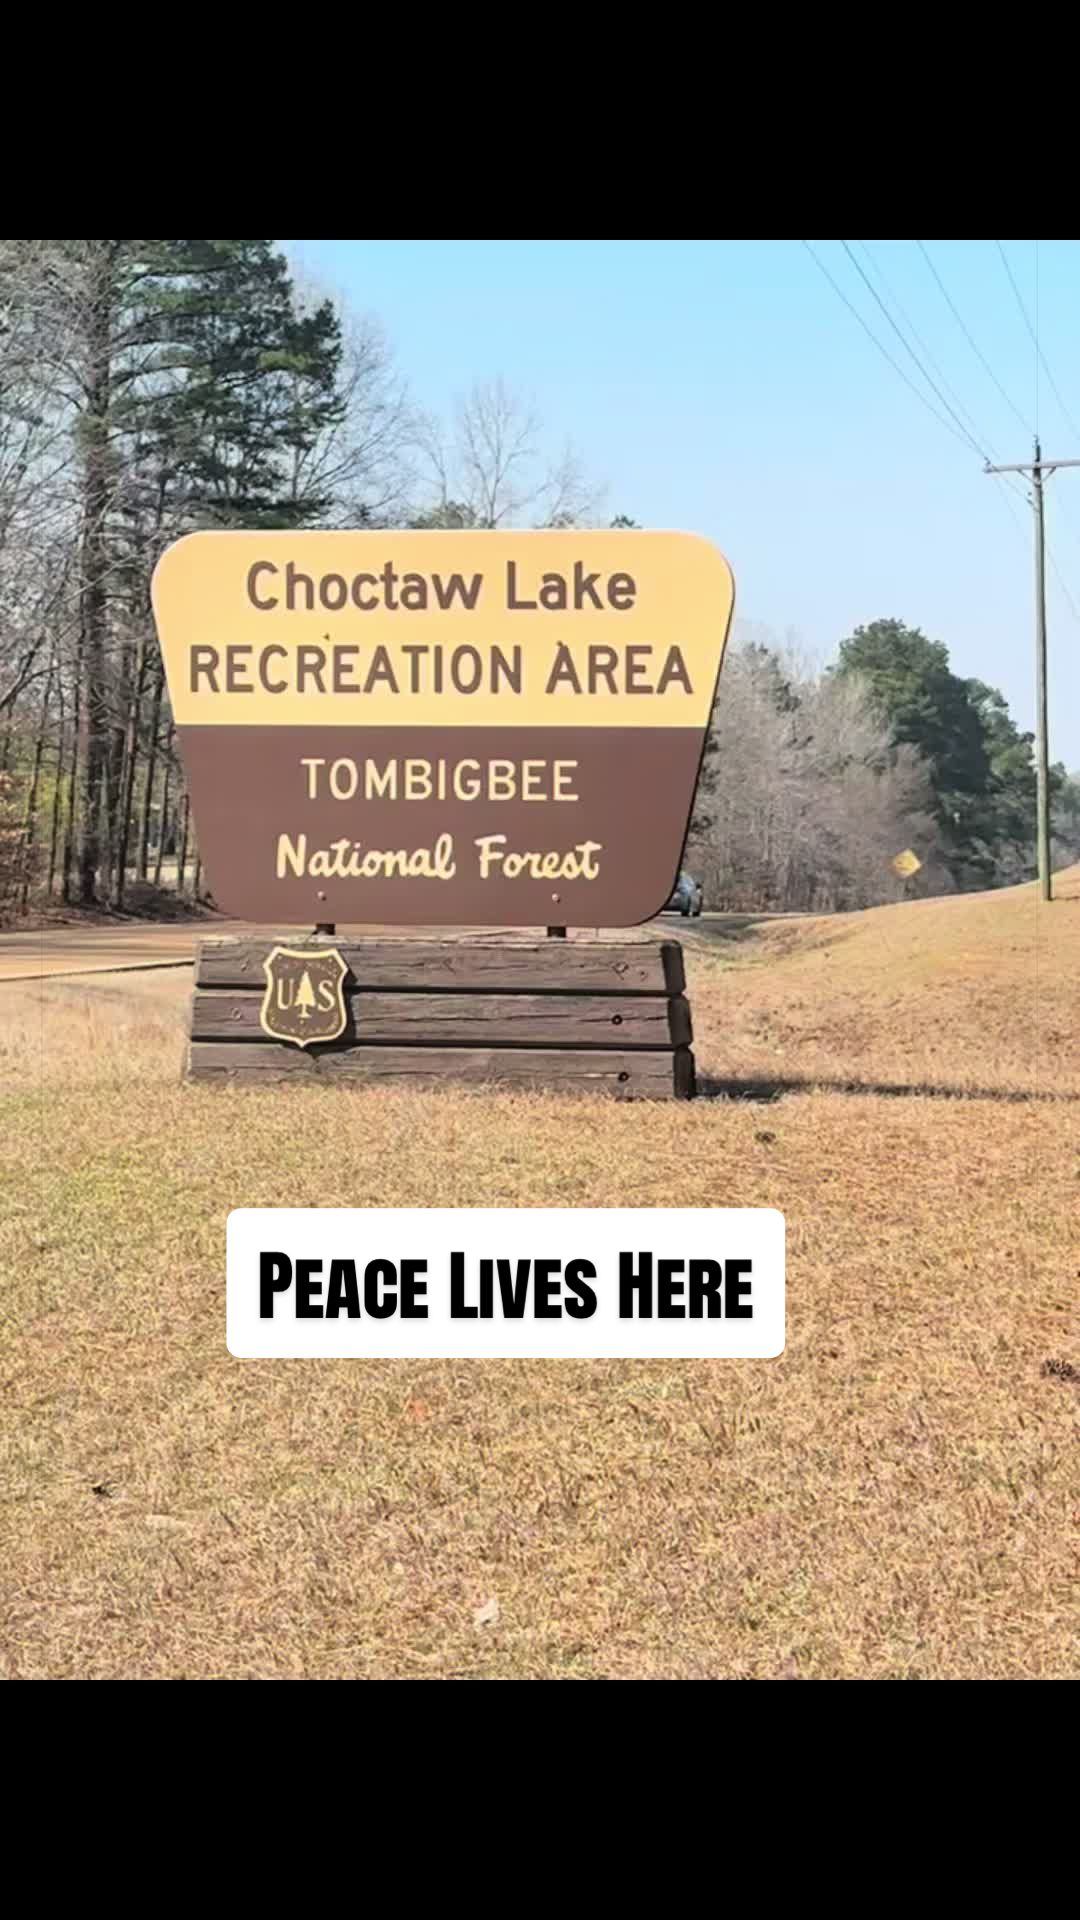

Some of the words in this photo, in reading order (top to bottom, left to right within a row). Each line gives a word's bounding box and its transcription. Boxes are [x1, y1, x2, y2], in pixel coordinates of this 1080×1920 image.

[247, 560, 484, 611] Choctaw
[506, 560, 637, 611] Lake
[190, 645, 522, 695] RECREATION
[545, 643, 694, 695] AREA
[300, 757, 579, 801] TOMBIGBEE
[276, 833, 457, 880] National
[474, 834, 602, 880] Forest
